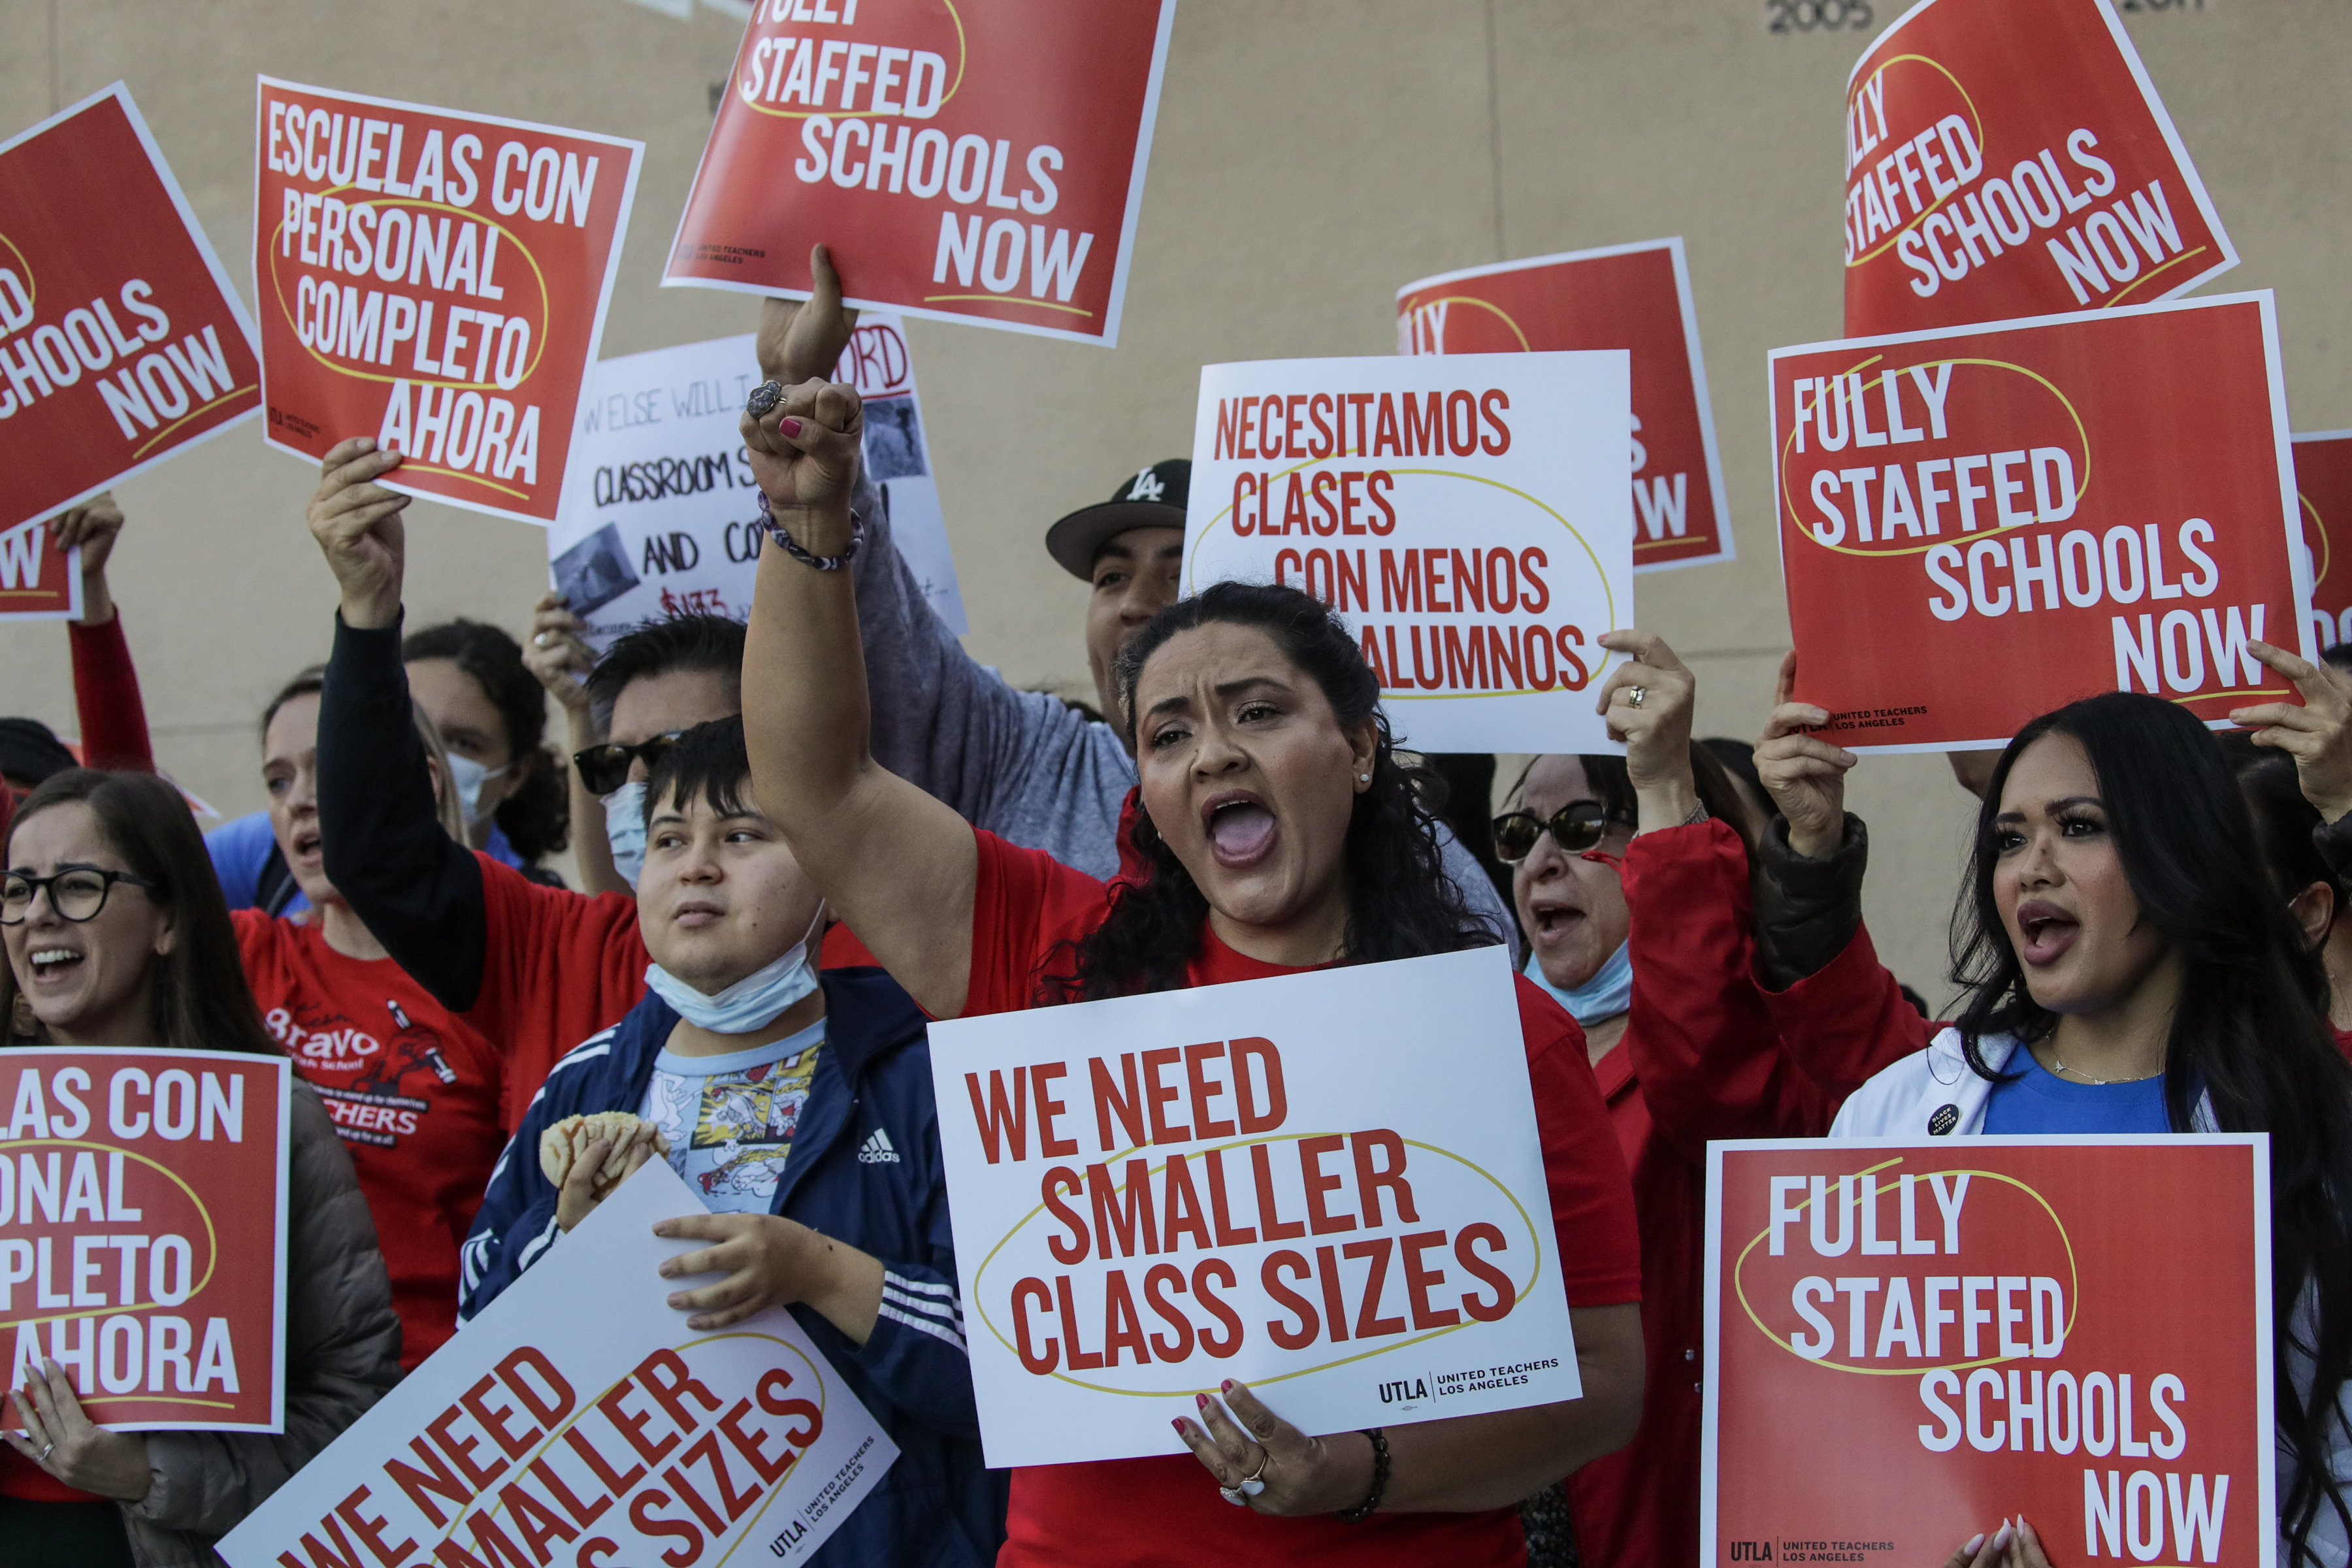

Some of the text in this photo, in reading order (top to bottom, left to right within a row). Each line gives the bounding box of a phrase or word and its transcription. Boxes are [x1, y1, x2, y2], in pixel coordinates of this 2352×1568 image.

[1765, 0, 1874, 35] 2005
[743, 37, 946, 118] STAFFED
[269, 100, 598, 228] ESCUELAS CON
[795, 114, 1063, 215] SCHOOLS
[1845, 114, 1984, 267] STAFFED
[282, 188, 504, 301] PERSONAL
[723, 246, 765, 258] TEACHERS
[1897, 128, 2116, 298] SCHOOLS
[2046, 180, 2184, 306] NOW
[710, 253, 743, 264] ANGELES
[934, 211, 1093, 302] NOW
[0, 278, 170, 419] HOOLS
[297, 274, 531, 391] COMPLETO
[95, 324, 235, 441] NOW
[607, 387, 663, 433] ELSE
[670, 378, 732, 418] WILL
[1215, 389, 1511, 461] NECESITAMOS
[1794, 363, 1953, 453] FULLY
[378, 378, 540, 485] AHORA
[1126, 466, 1166, 501] LA
[1232, 470, 1396, 536] CLASES
[1810, 446, 2077, 547] STAFFED
[643, 531, 699, 575] AND
[1275, 547, 1550, 614] CON MENOS
[1925, 518, 2219, 621] SCHOOLS
[1361, 625, 1589, 691] ALUMNOS
[2112, 604, 2265, 694] NOW
[1833, 706, 1927, 721] UNITED TEACHERS
[1836, 722, 1855, 730] LOS
[1859, 718, 1904, 728] ANGELES
[266, 1007, 380, 1058] Bravo
[108, 1067, 244, 1142] CON
[964, 1036, 1288, 1165] WE NEED
[1932, 1107, 1952, 1122] BLACK
[1933, 1116, 1956, 1135] MATTER
[1935, 1113, 1952, 1127] LIVES
[858, 1149, 900, 1164] adidas
[1041, 1128, 1420, 1266] SMALLER
[1769, 1173, 1971, 1258] FULLY
[1011, 1222, 1516, 1376] CLASS SIZES
[1790, 1275, 2064, 1360] STAFFED
[11, 1314, 240, 1394] AHORA
[1379, 1358, 1559, 1403] UTLA UNITED TEACHERS
[1439, 1375, 1529, 1396] LOS ANGELES
[383, 1346, 576, 1529] NEED
[1918, 1368, 2186, 1461] SCHOOLS
[406, 1348, 723, 1568] MALLER
[629, 1367, 823, 1568] SIZES
[769, 1435, 874, 1558] UTLA UNITED TEACHERS
[811, 1463, 864, 1523] LOS ANGELES
[1731, 1541, 1894, 1561] UTLA UNITED TEACHERS
[1810, 1553, 1864, 1561] ANGELES
[2083, 1469, 2229, 1563] NOW
